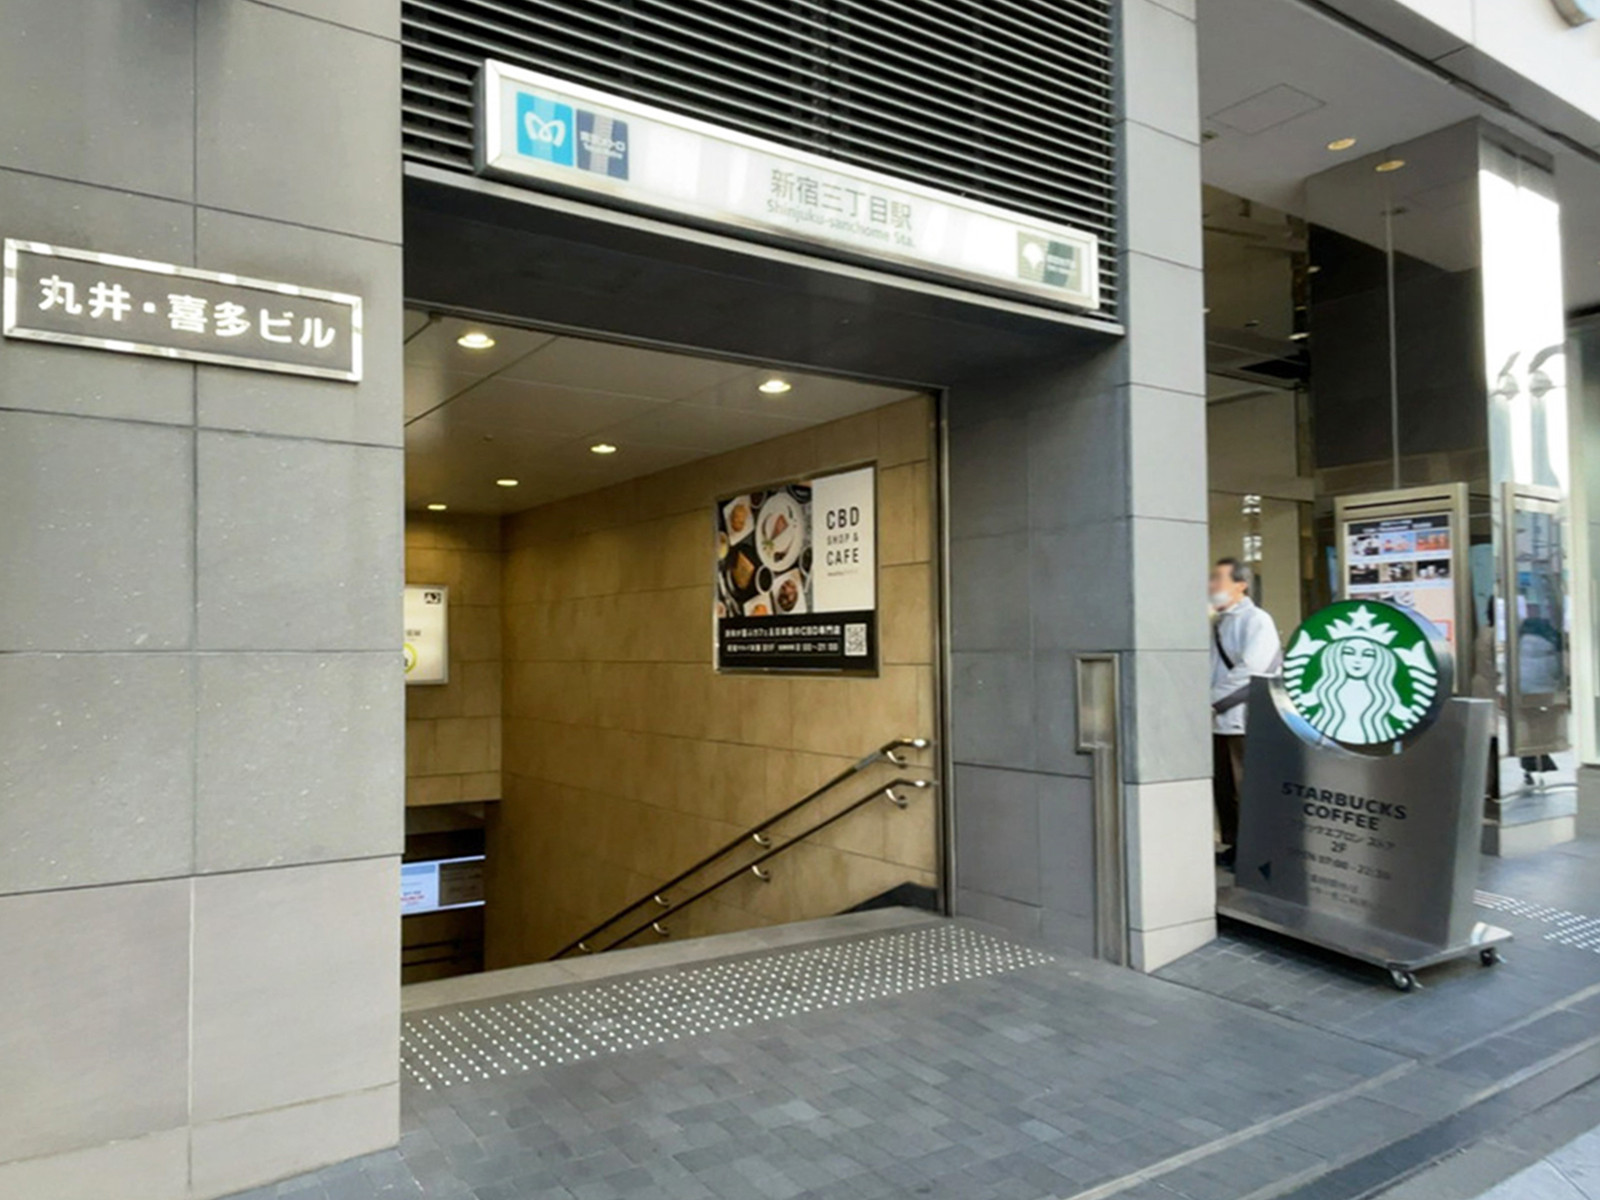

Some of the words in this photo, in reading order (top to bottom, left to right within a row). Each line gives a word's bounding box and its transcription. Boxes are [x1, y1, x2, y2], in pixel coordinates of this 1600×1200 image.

[770, 168, 913, 230] 新宿三丁目駅
[38, 274, 336, 348] 丸井・喜多ビル
[826, 506, 860, 530] CBD
[827, 532, 850, 546] SHOP
[826, 547, 859, 566] CAFE
[1281, 782, 1407, 820] STARBUCKS
[1303, 802, 1379, 831] COFFEE
